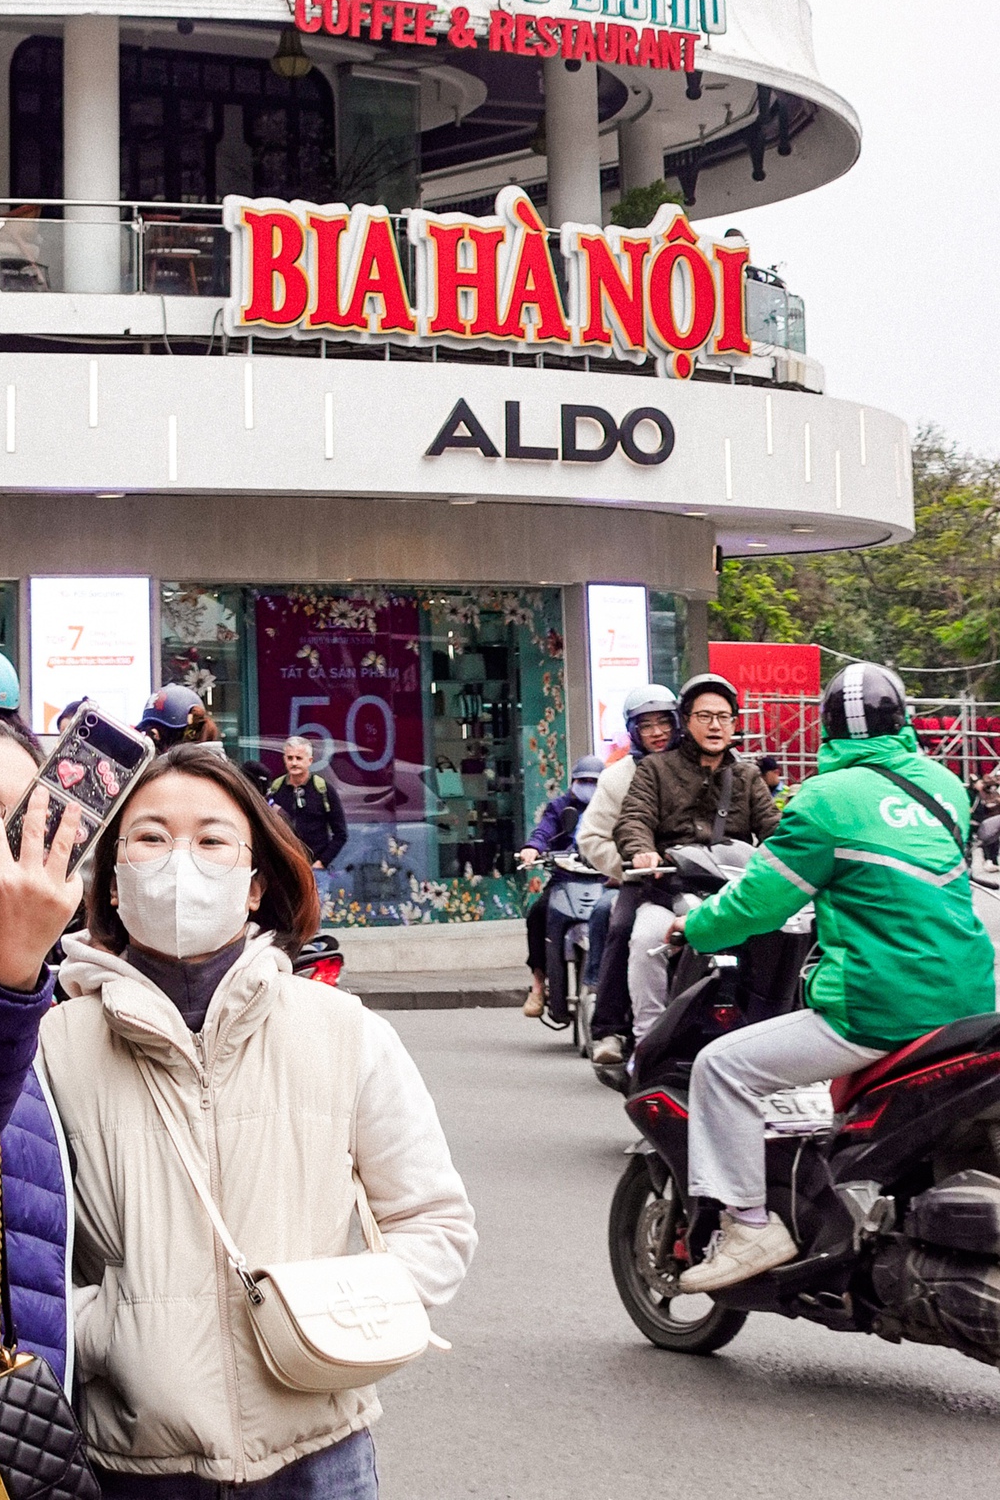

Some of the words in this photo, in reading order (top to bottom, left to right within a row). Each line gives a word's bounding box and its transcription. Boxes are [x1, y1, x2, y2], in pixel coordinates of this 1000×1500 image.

[448, 5, 477, 50] &
[488, 8, 701, 72] RESTAURANT
[240, 207, 418, 336] BIA
[426, 196, 574, 343] HÀ
[579, 214, 751, 381] NỘI
[424, 398, 675, 467] ALDO
[289, 695, 397, 773] 50
